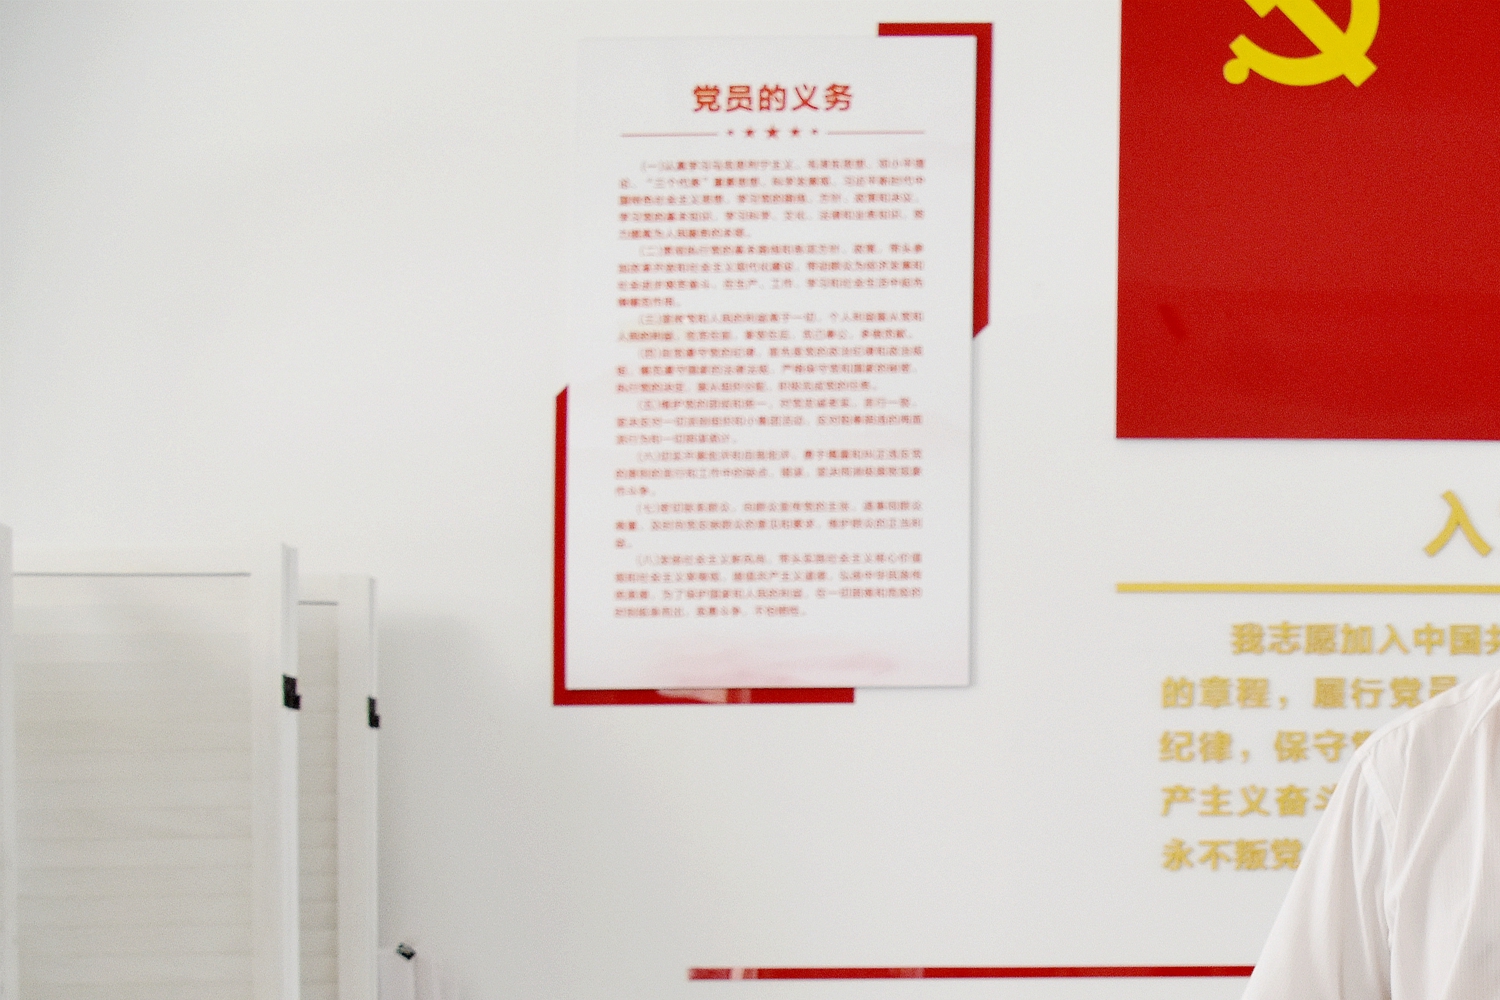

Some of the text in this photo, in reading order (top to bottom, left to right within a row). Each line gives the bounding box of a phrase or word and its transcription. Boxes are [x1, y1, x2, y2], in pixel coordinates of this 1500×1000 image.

[693, 83, 853, 114] 党员的义务
[1159, 730, 1374, 764] 纪律，保守
[1161, 837, 1302, 872] 永不叛党
